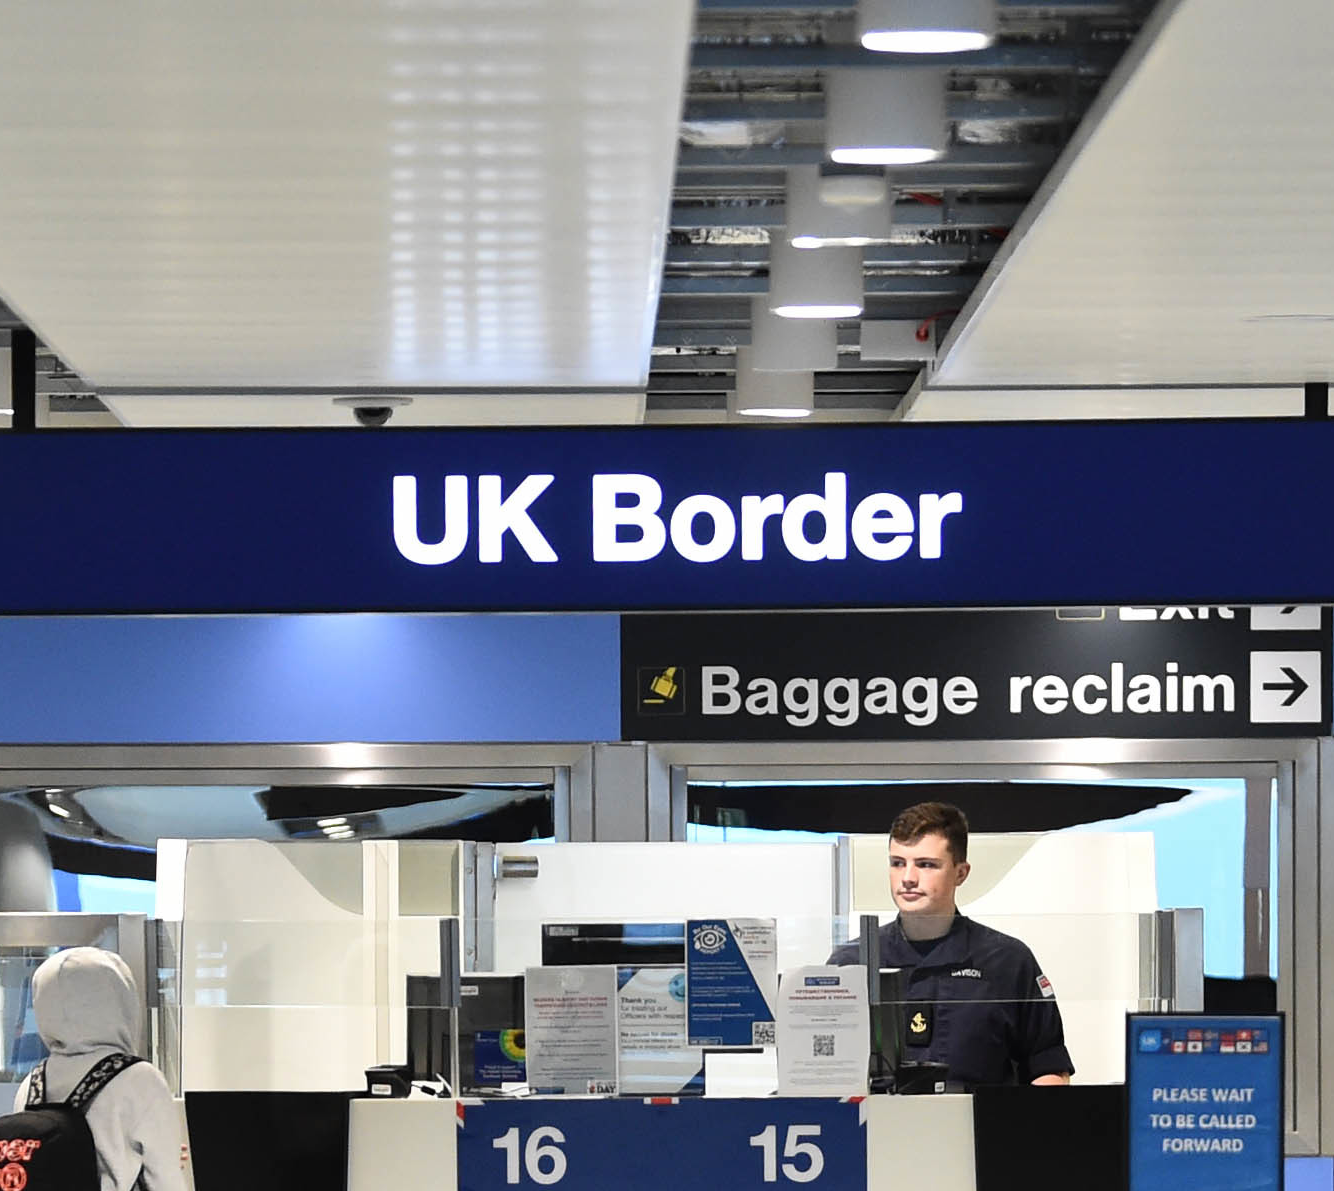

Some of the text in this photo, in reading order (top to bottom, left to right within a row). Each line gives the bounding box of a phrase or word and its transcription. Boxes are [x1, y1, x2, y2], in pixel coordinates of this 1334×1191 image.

[392, 471, 963, 566] UK Border
[701, 661, 1236, 727] Baggage reclaim
[597, 1085, 616, 1094] DAY
[1152, 1087, 1255, 1103] PLEASE WAIT
[1150, 1113, 1257, 1130] TO BE CALLED
[492, 1126, 567, 1185] 16
[749, 1124, 825, 1183] 15
[1162, 1137, 1244, 1153] FORWARD
